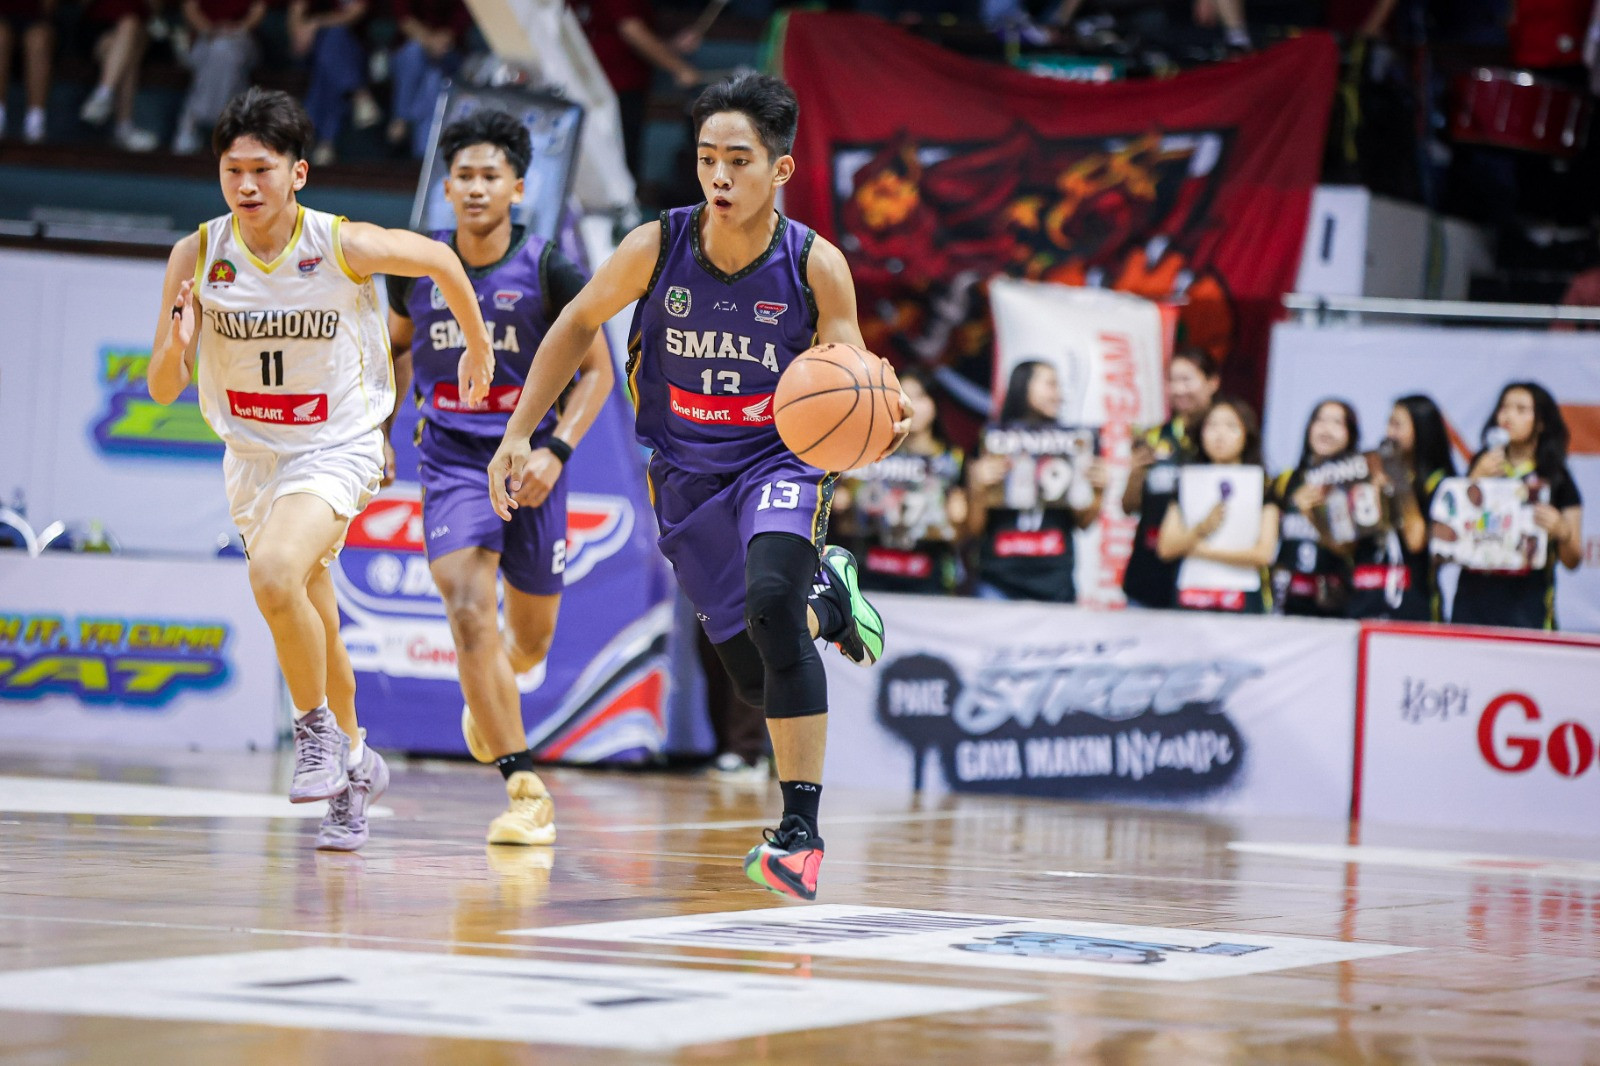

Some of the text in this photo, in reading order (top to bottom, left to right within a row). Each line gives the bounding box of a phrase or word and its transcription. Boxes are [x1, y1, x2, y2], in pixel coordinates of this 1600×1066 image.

[430, 319, 520, 353] SMLA
[666, 327, 780, 373] SMALA
[260, 351, 283, 386] 11
[252, 406, 284, 421] HEART.
[672, 400, 731, 421] One HEART.
[742, 414, 773, 422] HONDA
[757, 479, 800, 512] 13
[0, 659, 212, 692] AT
[1477, 690, 1600, 779] Go
[956, 739, 1023, 782] GAYA
